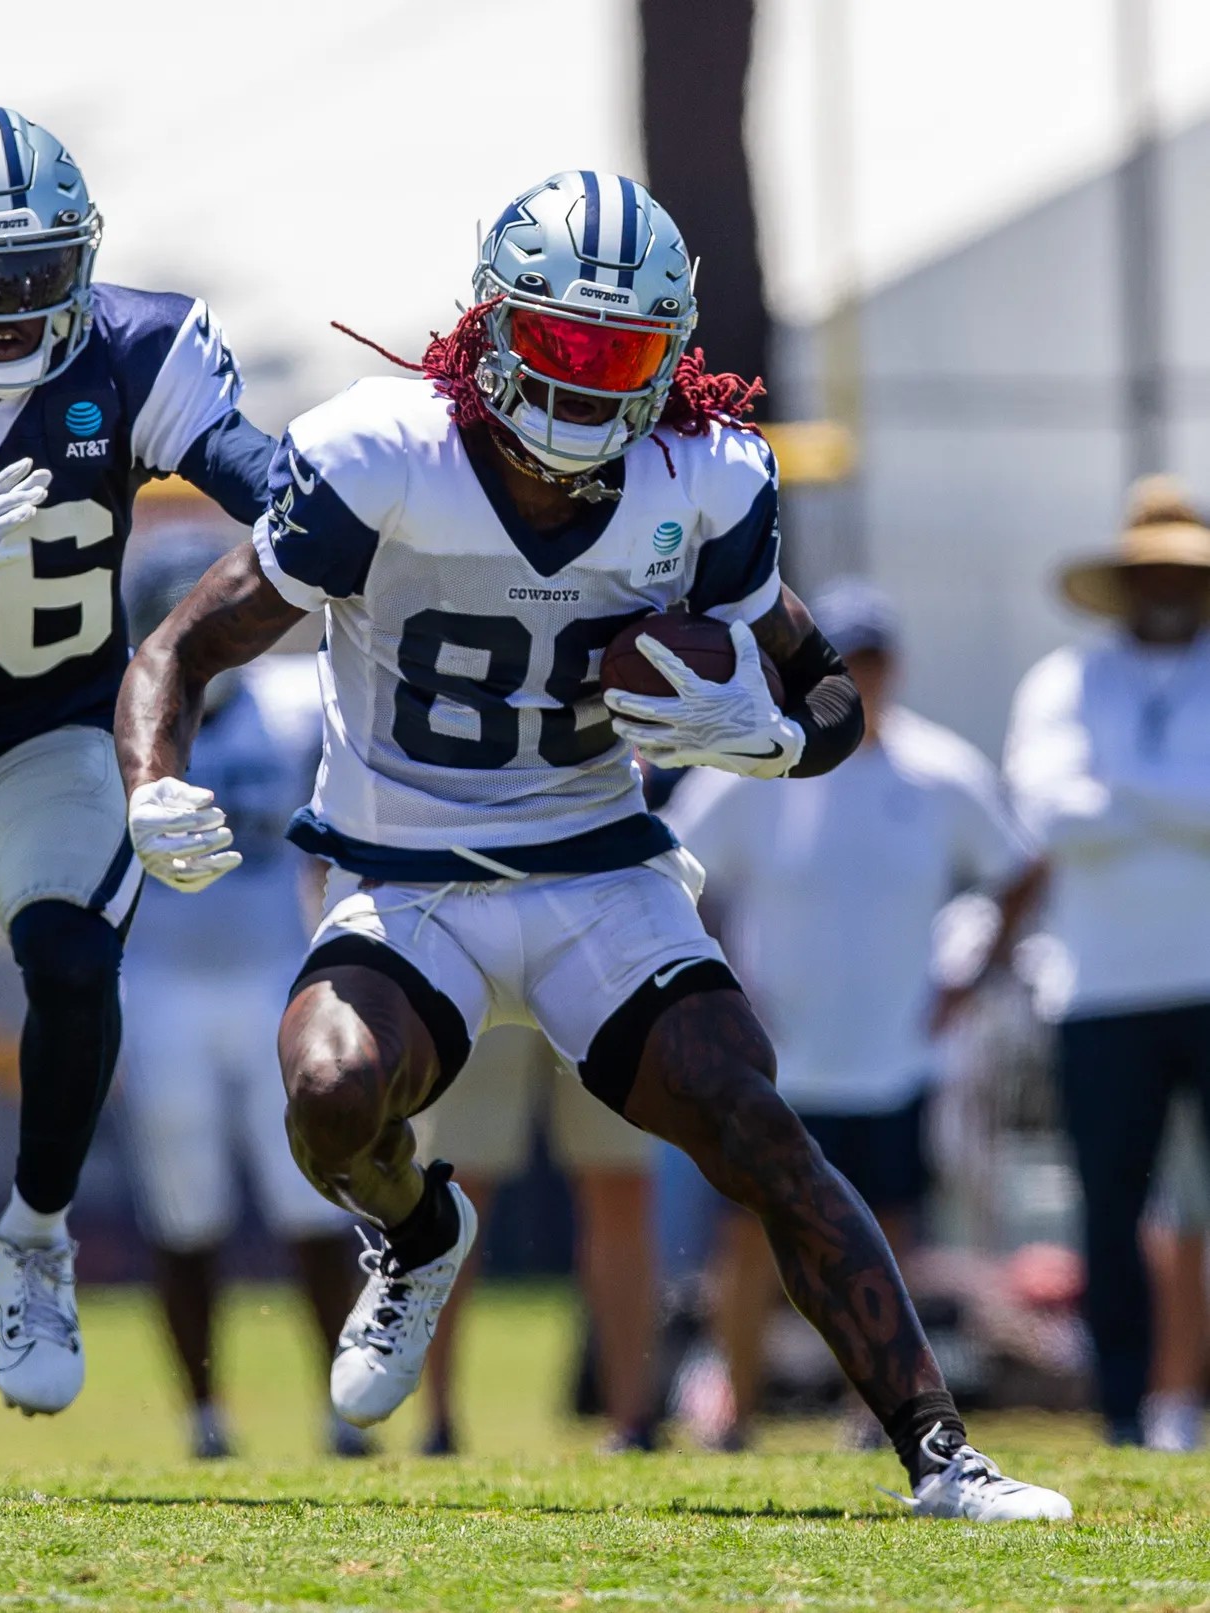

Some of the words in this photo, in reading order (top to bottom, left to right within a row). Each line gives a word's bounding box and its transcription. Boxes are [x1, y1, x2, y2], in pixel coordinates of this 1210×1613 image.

[580, 286, 630, 304] COWBOYS
[65, 438, 110, 459] AT&T
[645, 557, 680, 578] AT&T
[508, 587, 581, 602] COWBOYS
